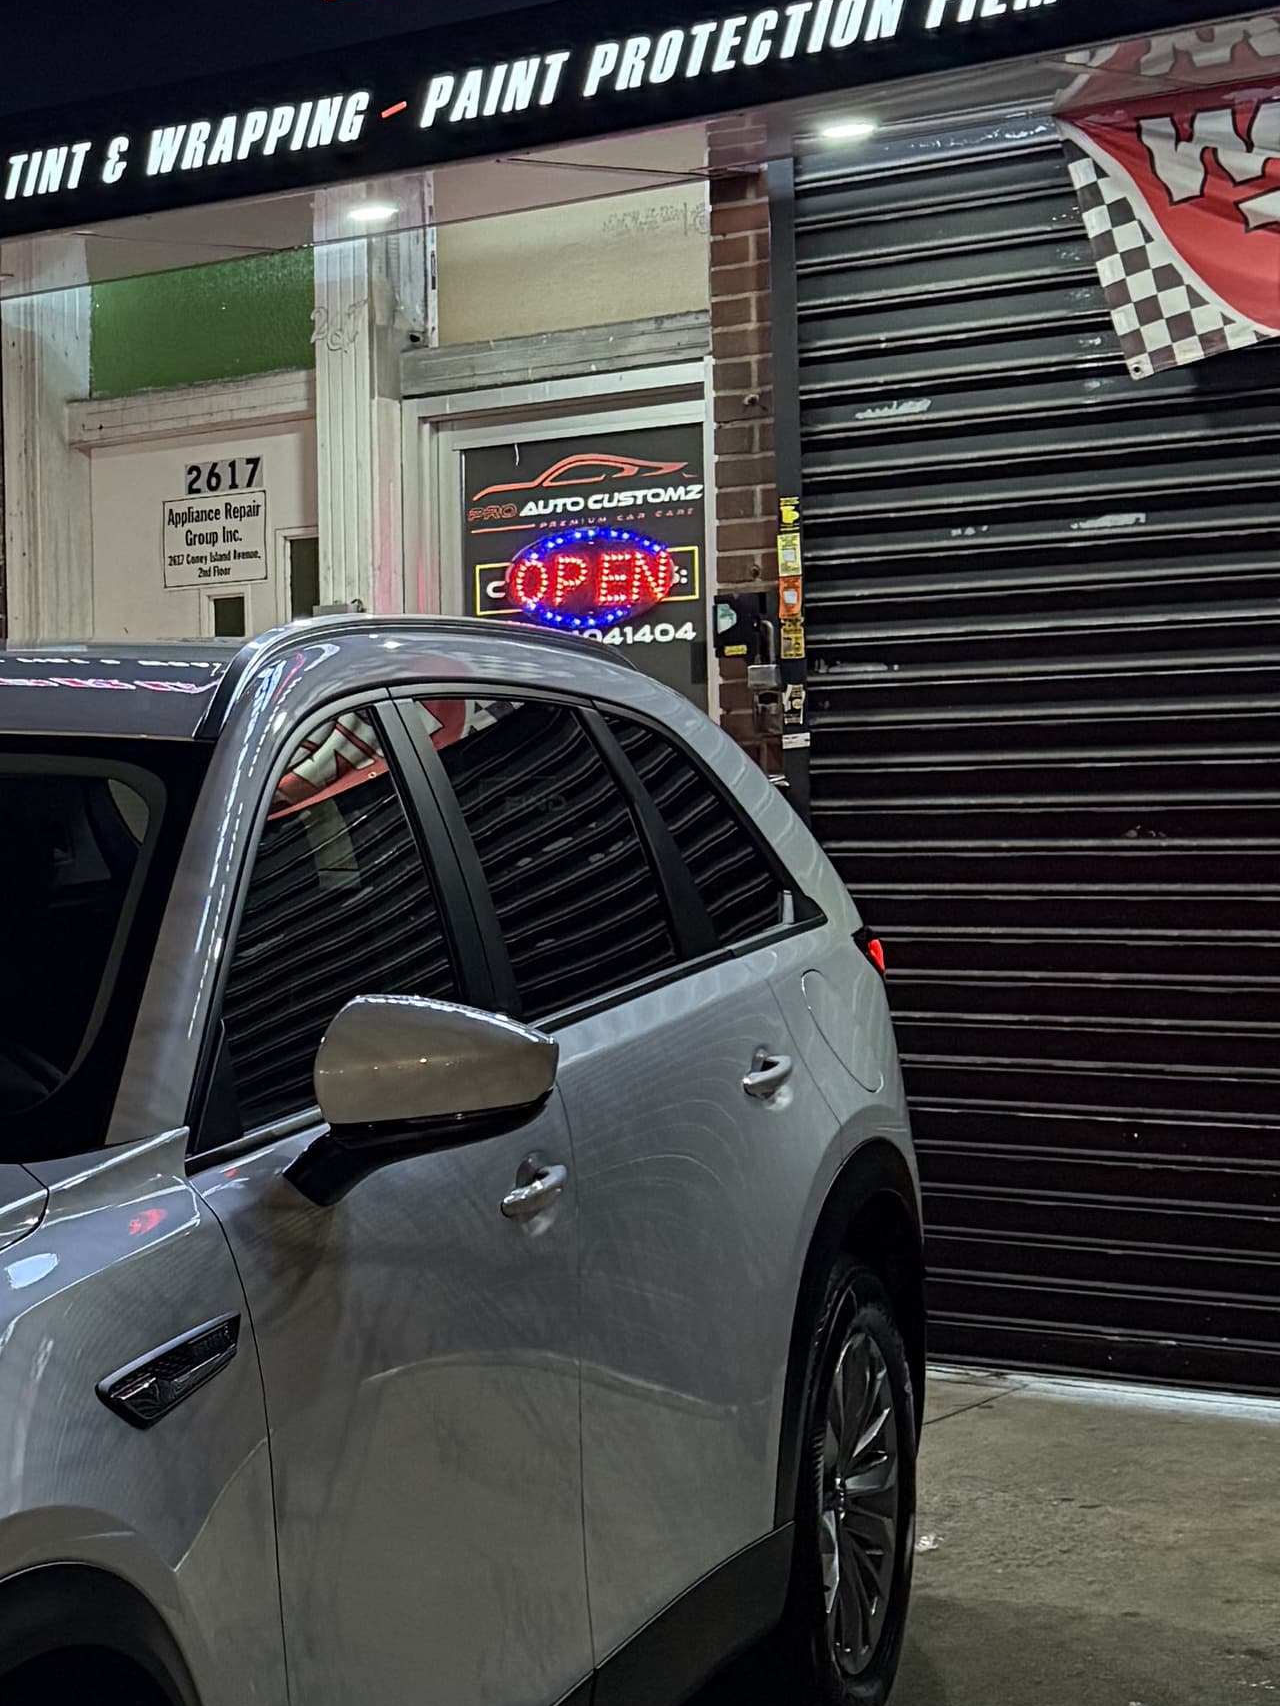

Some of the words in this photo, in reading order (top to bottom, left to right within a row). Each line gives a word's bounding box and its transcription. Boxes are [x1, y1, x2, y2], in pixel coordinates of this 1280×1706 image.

[4, 141, 94, 201] TINT
[101, 135, 130, 185] &
[146, 90, 371, 177] WRAPPING
[419, 49, 572, 129] PAINT
[186, 456, 262, 495] 2617
[167, 505, 221, 529] Appliance
[223, 499, 262, 522] Repair
[467, 503, 518, 523] PRO
[519, 495, 585, 518] AUTO
[586, 484, 705, 511] CUSTOMZ
[539, 516, 608, 530] PREMIUM
[615, 511, 647, 523] CAR
[654, 506, 696, 518] CARE
[185, 528, 219, 548] Group
[221, 525, 243, 544] Inc.
[185, 553, 208, 566] Coney
[209, 549, 232, 564] Island
[197, 565, 212, 579] 2nd
[212, 565, 232, 577] Floor
[514, 549, 670, 609] OPEN
